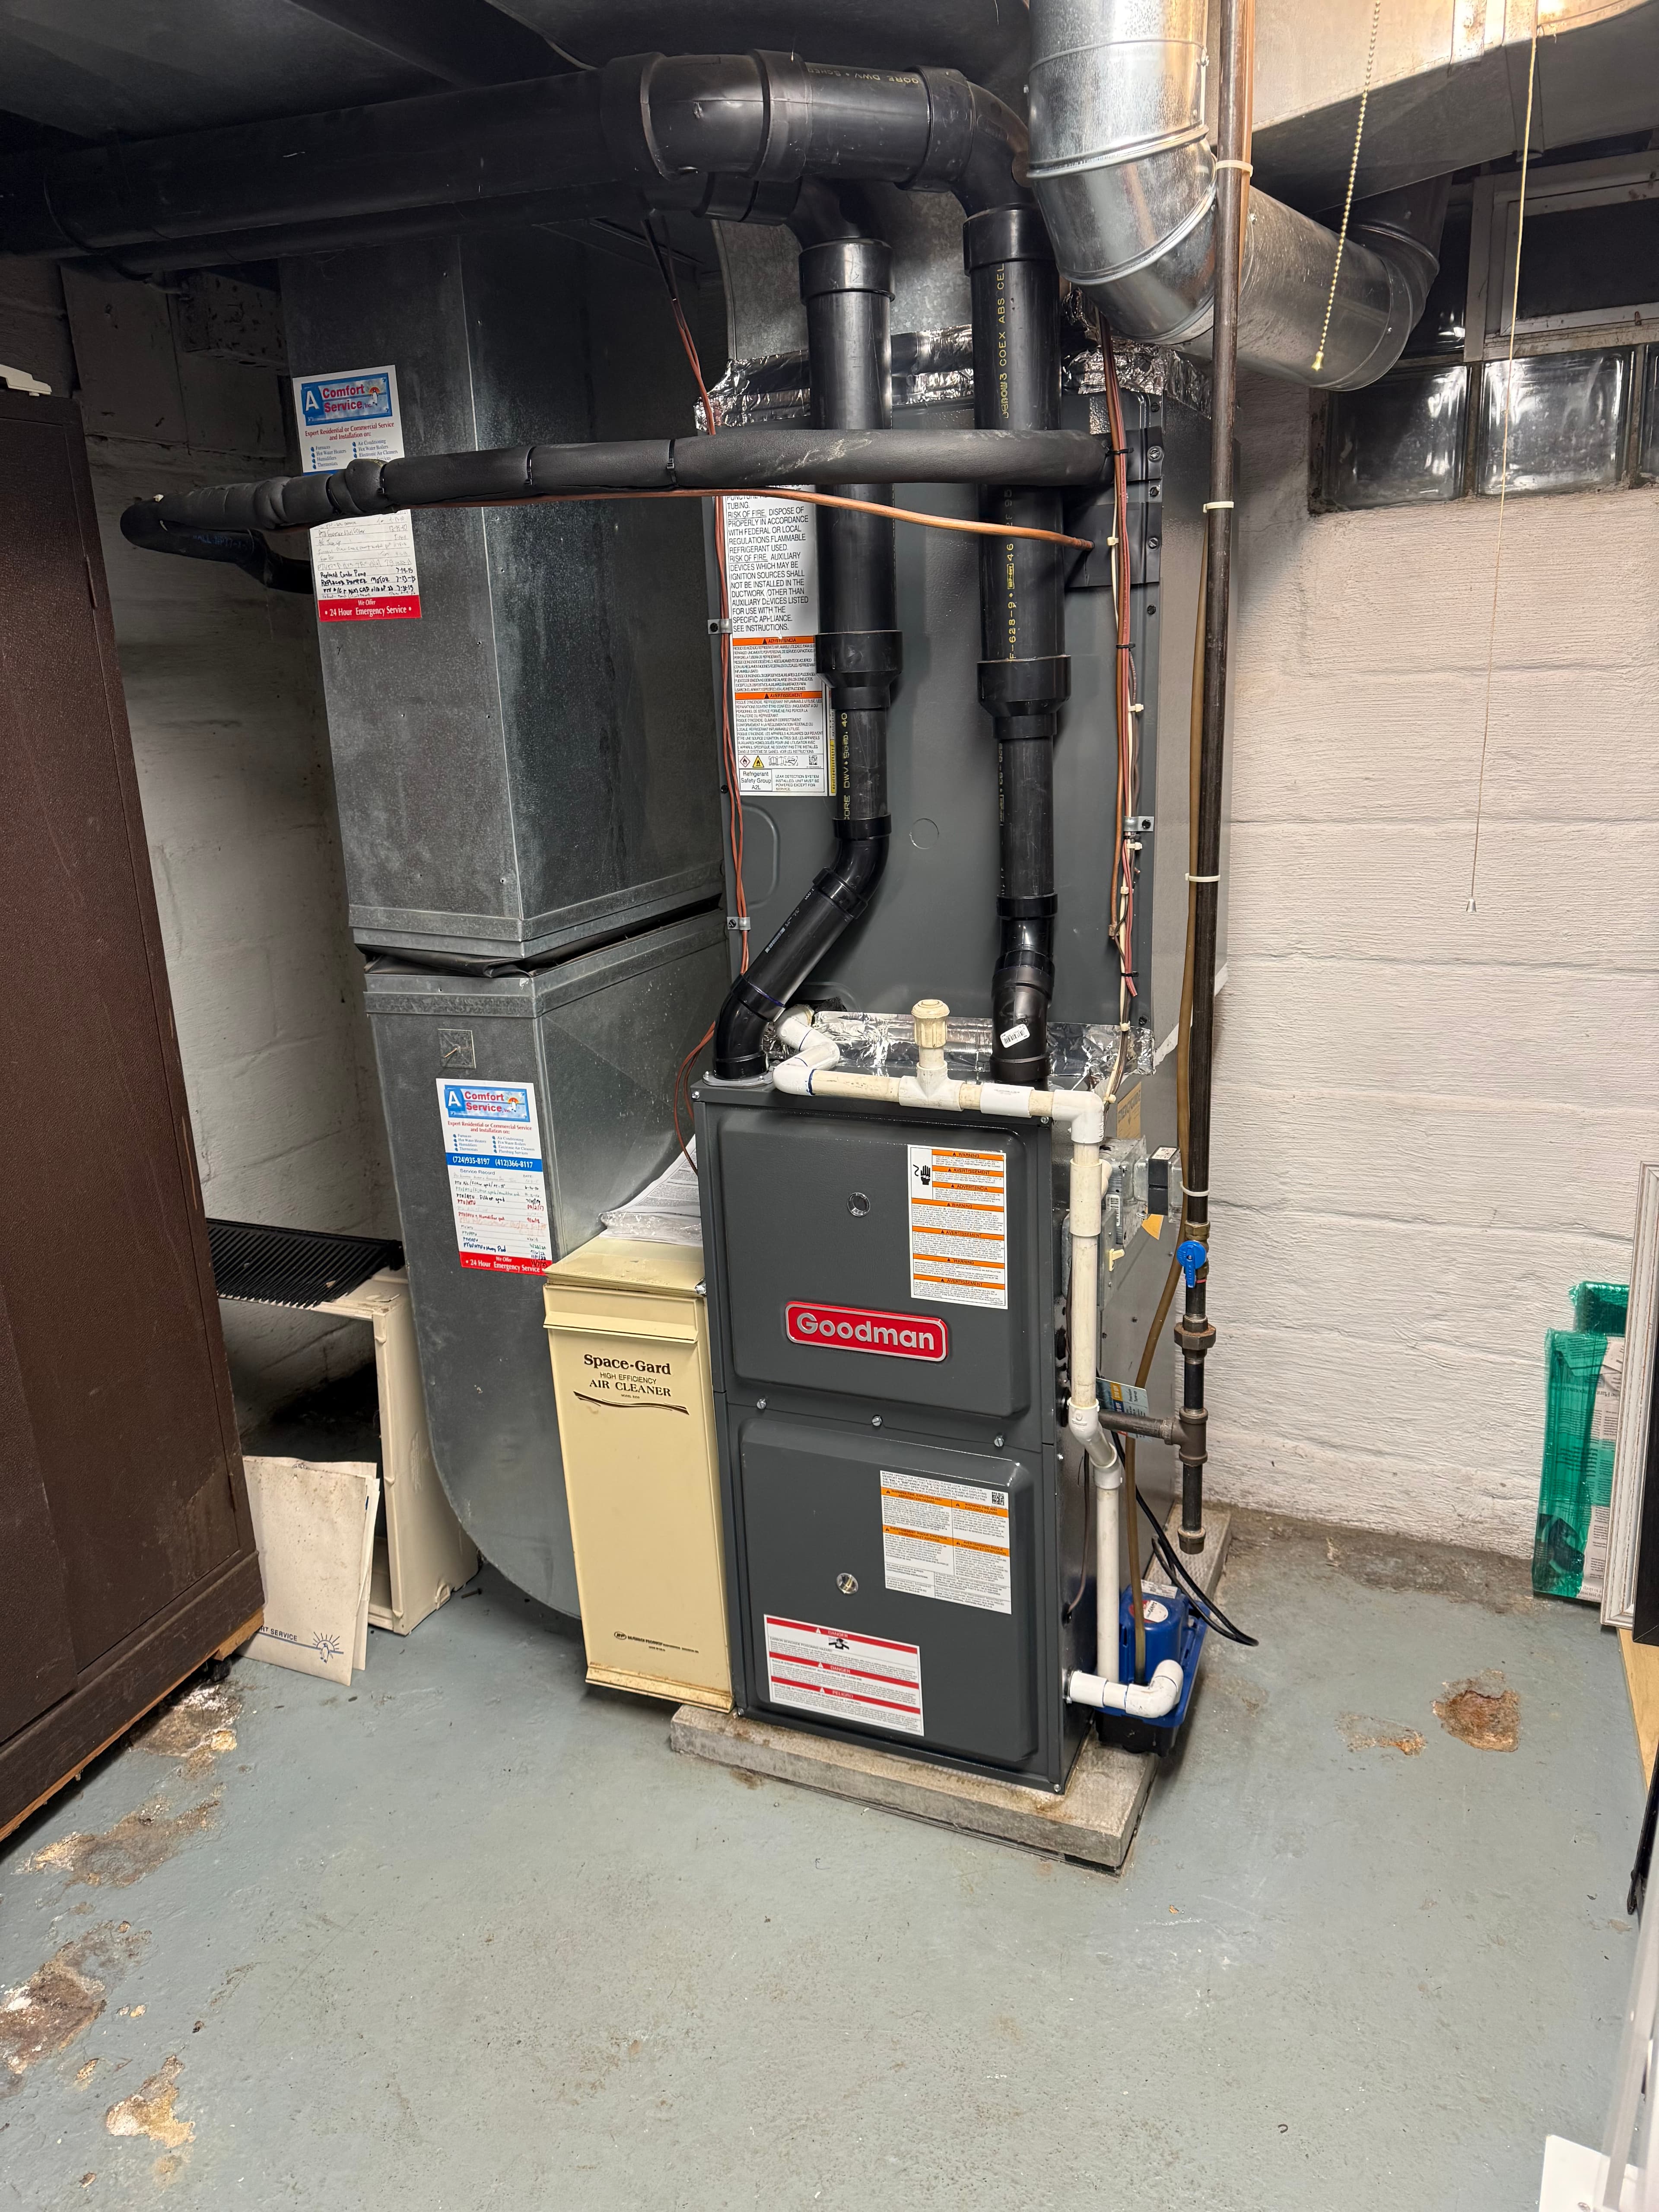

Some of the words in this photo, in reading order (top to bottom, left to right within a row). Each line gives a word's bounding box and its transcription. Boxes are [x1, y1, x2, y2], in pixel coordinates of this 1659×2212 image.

[305, 391, 319, 411] A
[322, 384, 365, 399] Comfort
[350, 423, 377, 432] Commercial
[769, 507, 794, 516] DISPOSE
[767, 515, 808, 525] ACCORDANCE
[730, 545, 770, 553] REFRIGERANT
[771, 552, 801, 560] AUXILIARY
[732, 589, 764, 597] DUCTWORK
[356, 607, 385, 617] Emergency
[387, 605, 407, 613] Service
[746, 623, 789, 632] INSTRUCTIONS.
[841, 712, 848, 728] 40
[448, 1091, 461, 1106] A
[464, 1091, 504, 1101] Comfort
[452, 1156, 490, 1165] (724)935-8197
[495, 1158, 533, 1169] (412)366-8117
[494, 1262, 520, 1272] Emergency
[797, 1313, 934, 1350] Goodman
[584, 1354, 671, 1375] Space-Gard
[619, 1374, 657, 1384] EFFICIENCY
[589, 1379, 610, 1389] AIR
[615, 1382, 671, 1397] CLEANER
[270, 1628, 297, 1642] SERVICE
[828, 1630, 848, 1638] DANGER
[830, 1665, 850, 1674] DANGER
[833, 1690, 853, 1698] PELIGRO
